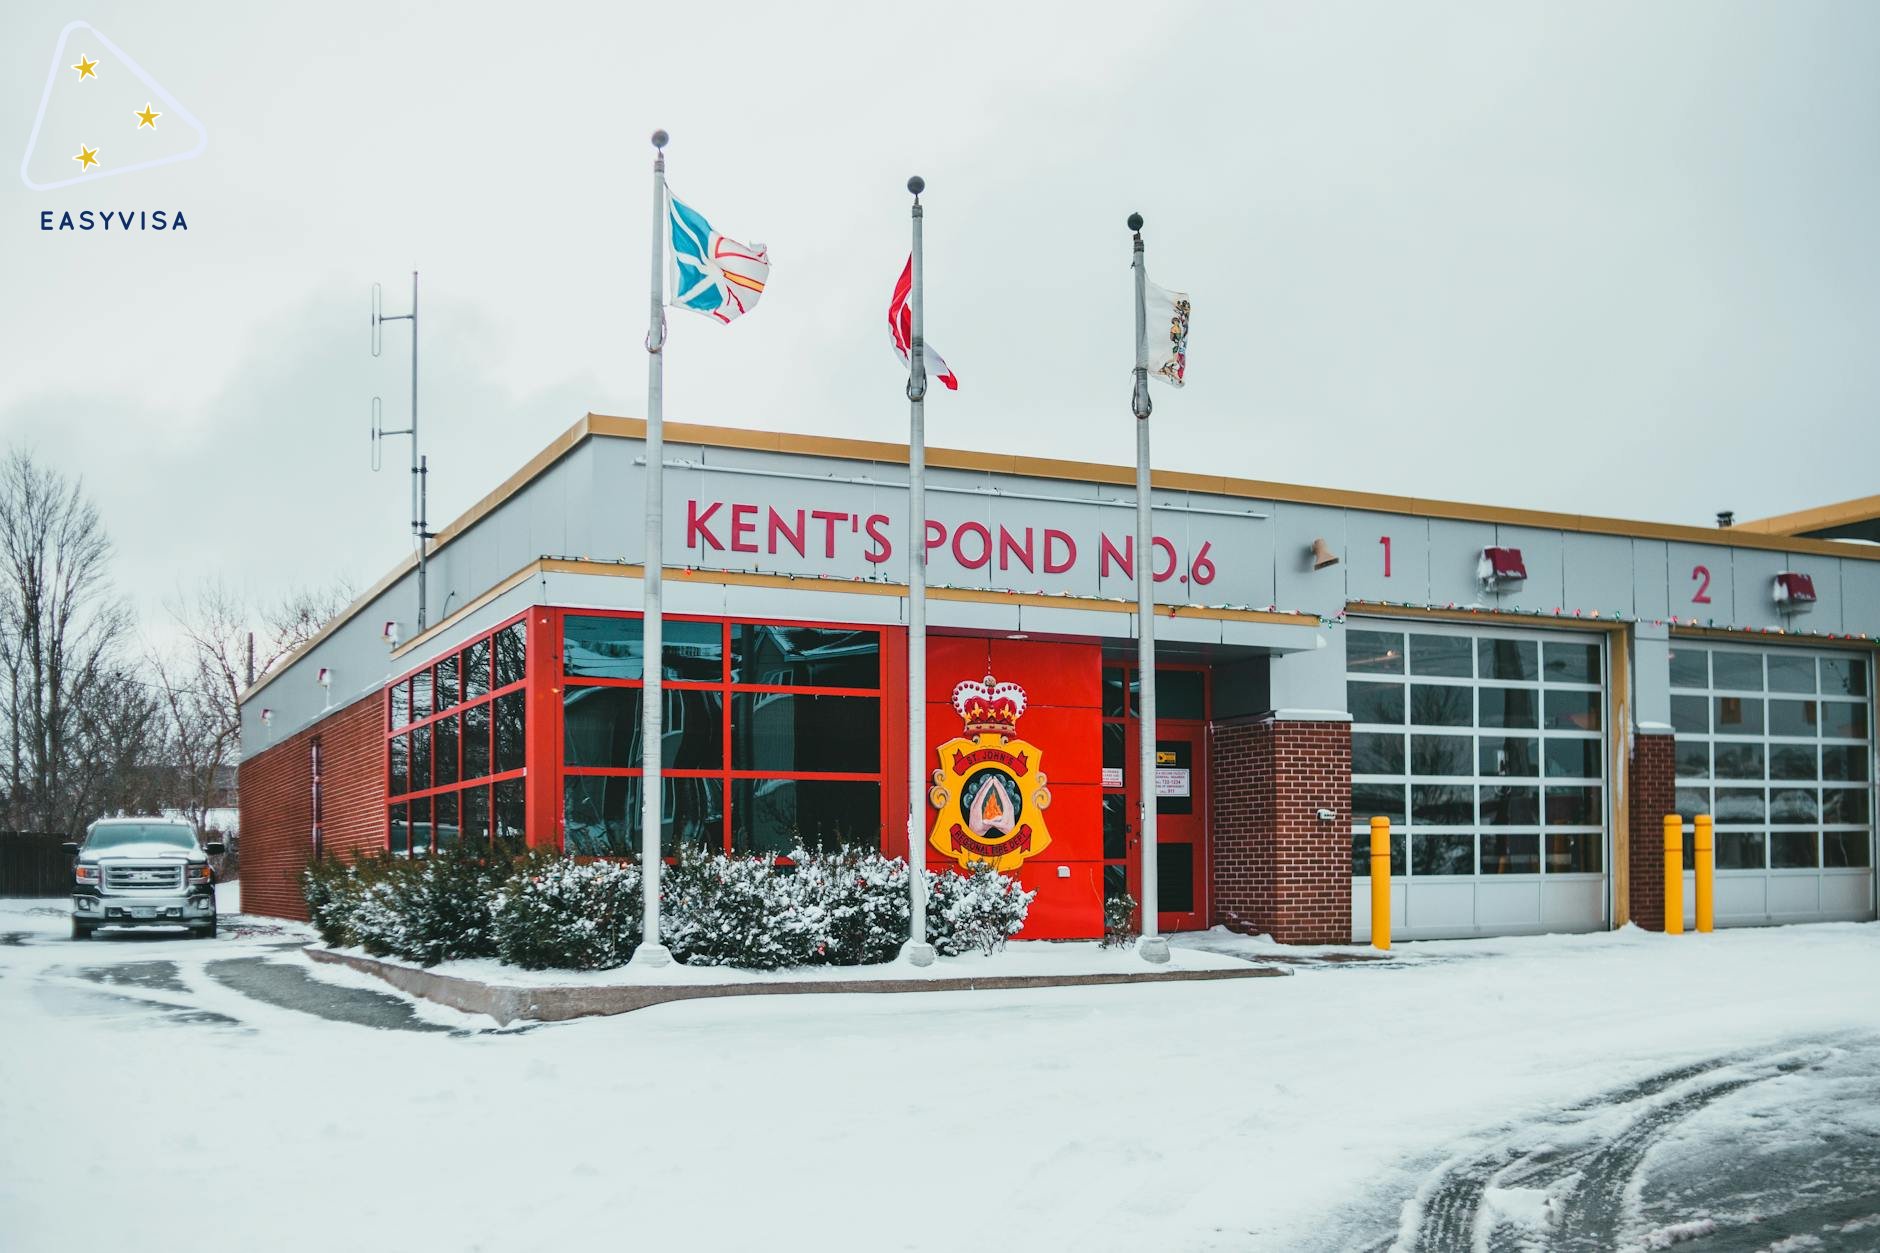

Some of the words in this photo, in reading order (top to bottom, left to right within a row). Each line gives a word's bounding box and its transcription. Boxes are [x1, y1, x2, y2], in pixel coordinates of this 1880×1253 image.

[687, 499, 892, 564] KENT'S
[924, 520, 1077, 574] POND
[1379, 536, 1391, 577] 1
[1692, 566, 1711, 603] 2
[983, 751, 1014, 766] JOHN'S
[955, 830, 988, 854] REGIONAL
